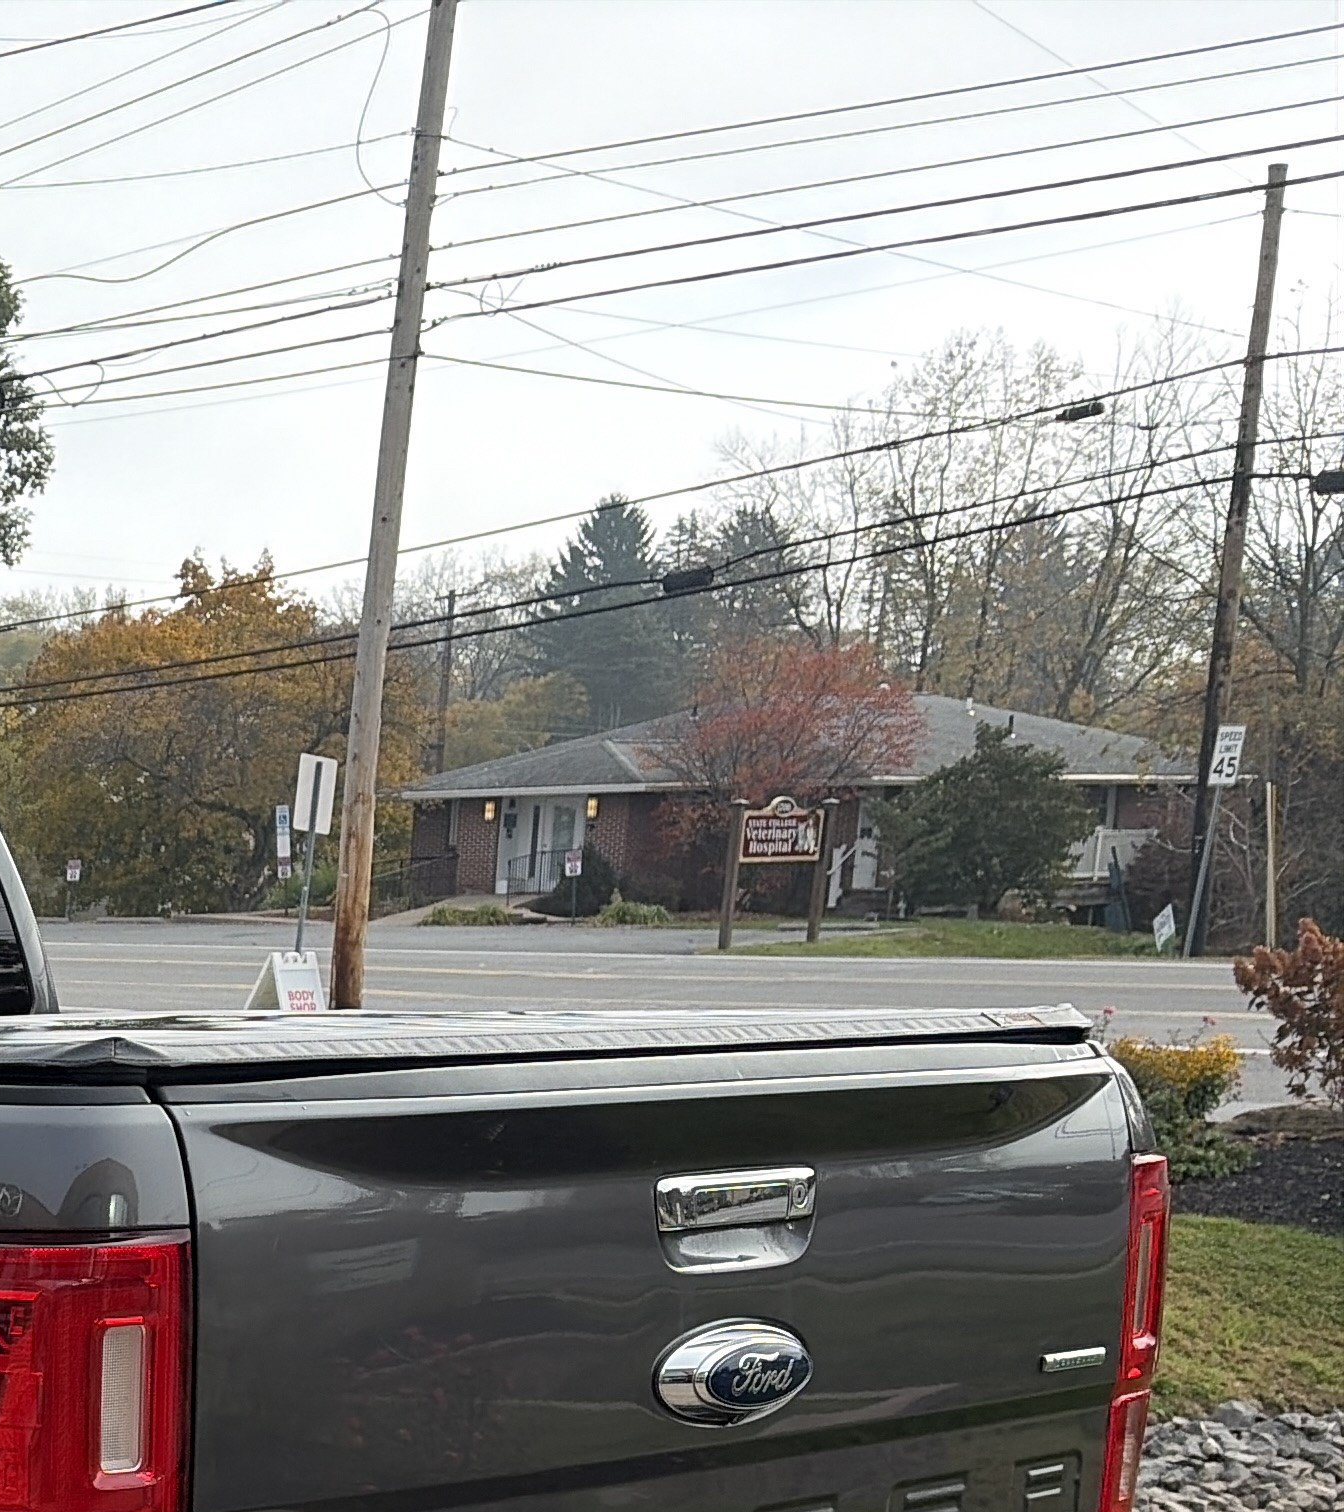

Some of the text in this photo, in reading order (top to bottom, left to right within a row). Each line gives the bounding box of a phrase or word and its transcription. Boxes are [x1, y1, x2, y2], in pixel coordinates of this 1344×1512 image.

[1220, 731, 1243, 742] SPEED
[1219, 743, 1238, 754] LIMIT
[1213, 756, 1237, 778] 45
[746, 827, 797, 842] Veterinary
[748, 840, 793, 857] Hospital
[288, 991, 315, 1001] BODY
[731, 1352, 795, 1397] Ford
